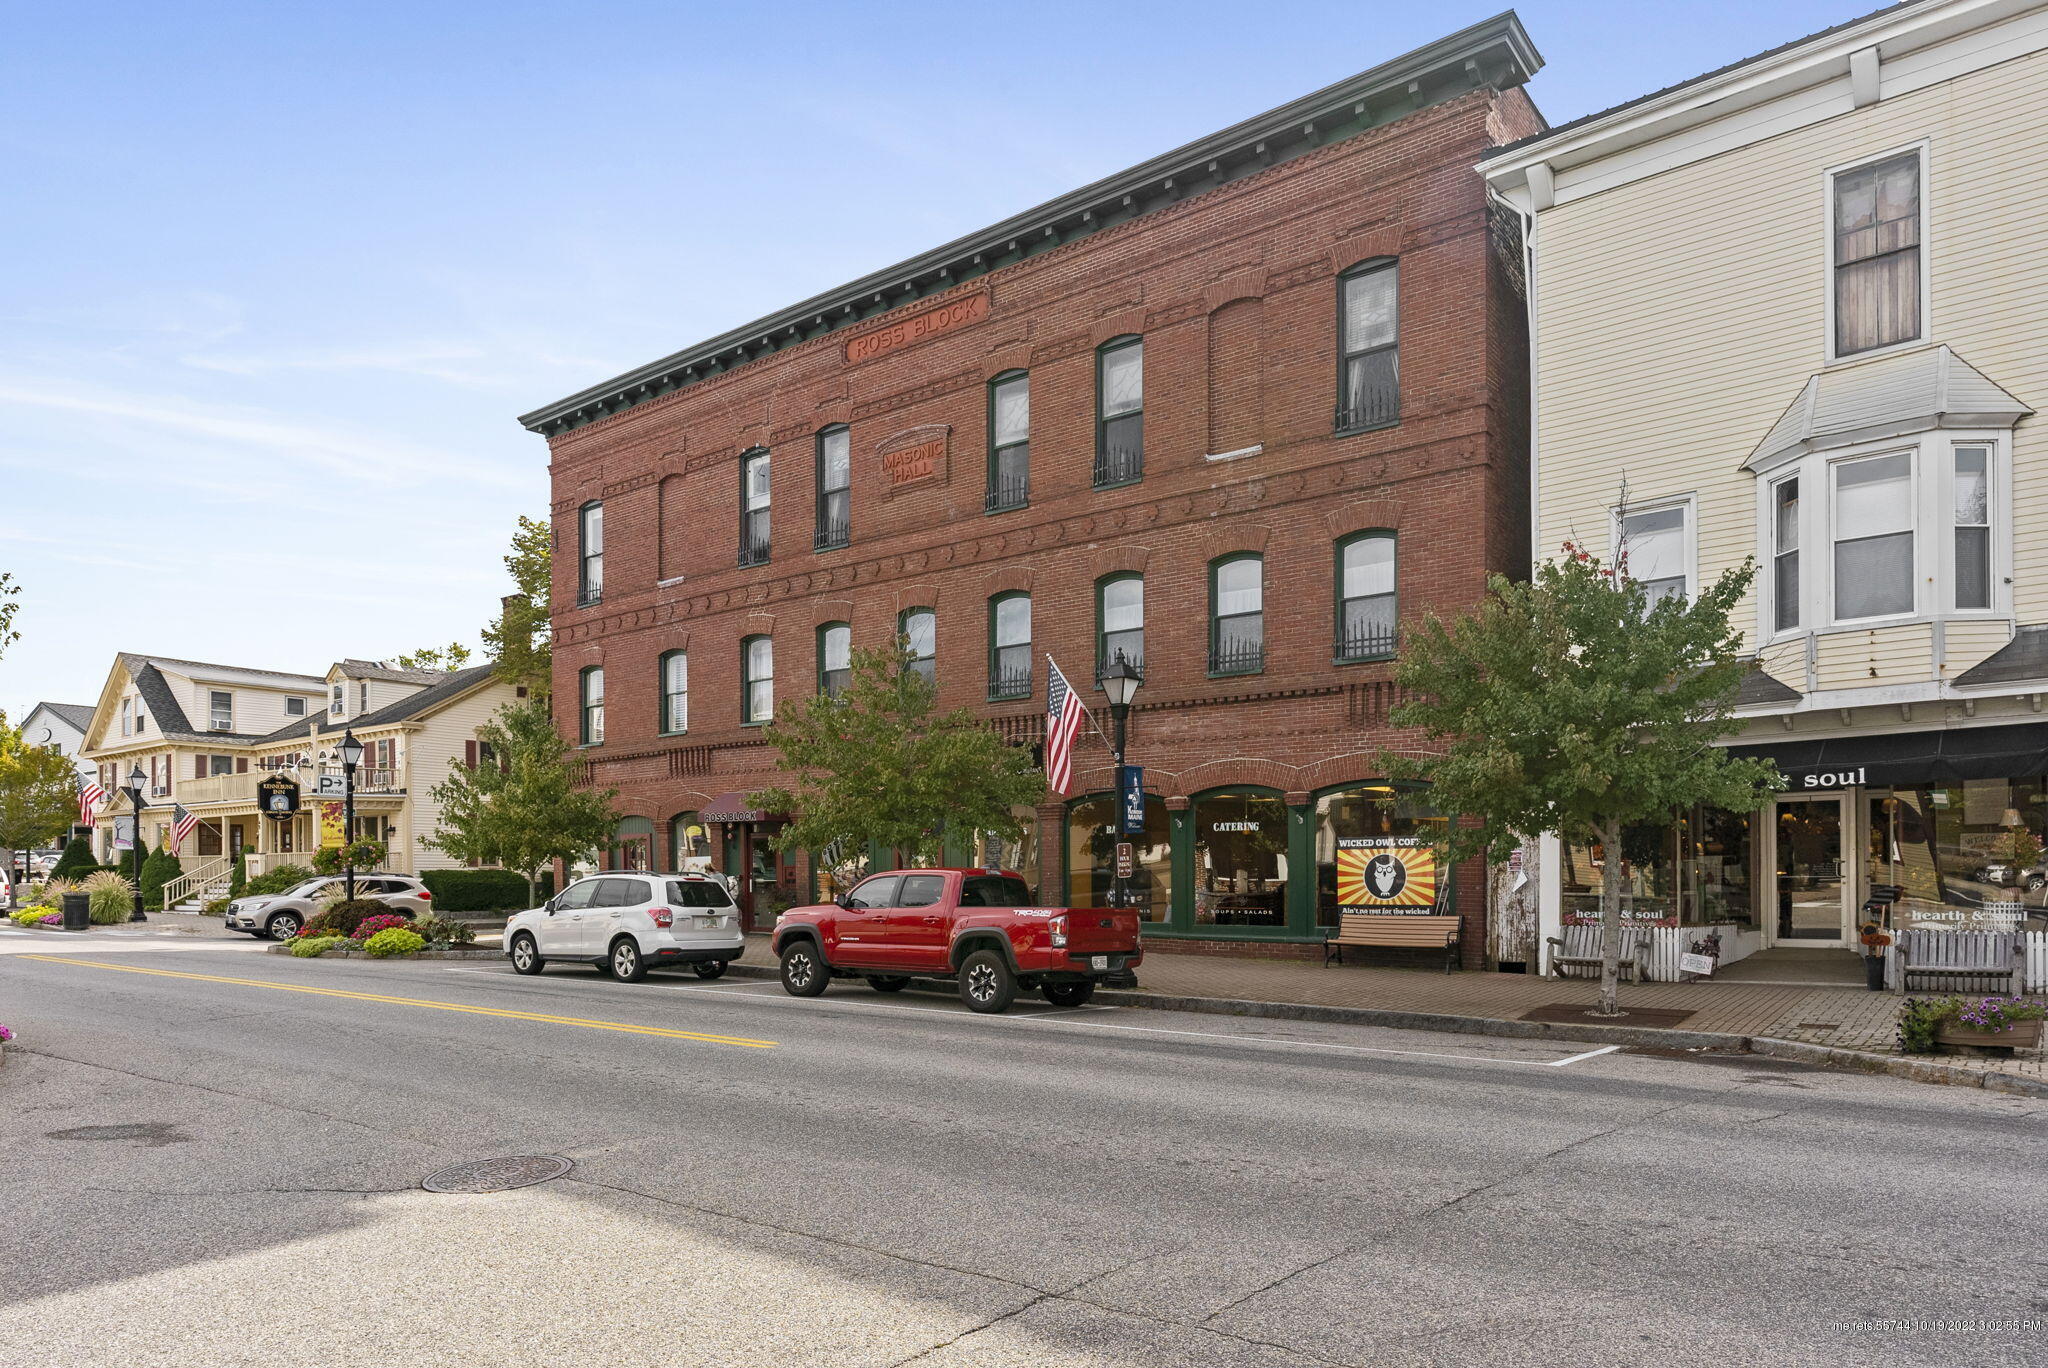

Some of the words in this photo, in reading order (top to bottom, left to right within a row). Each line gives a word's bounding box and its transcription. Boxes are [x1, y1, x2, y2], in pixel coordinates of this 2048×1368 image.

[856, 326, 905, 357] ROSS
[914, 298, 978, 338] BLOCK
[884, 442, 943, 470] MASONIC
[893, 462, 933, 483] HALL
[1804, 767, 1867, 788] soul
[704, 812, 727, 822] ROSS
[728, 810, 757, 821] BLOCK
[1213, 821, 1259, 832] CATERING
[1339, 839, 1374, 848] WICKED
[1376, 838, 1396, 847] OWL
[1398, 838, 1433, 846] COF
[1576, 909, 1606, 918] hear
[1620, 910, 1632, 919] &
[1635, 910, 1663, 919] soul
[1912, 910, 1966, 921] hearth
[1682, 957, 1712, 970] OPEN
